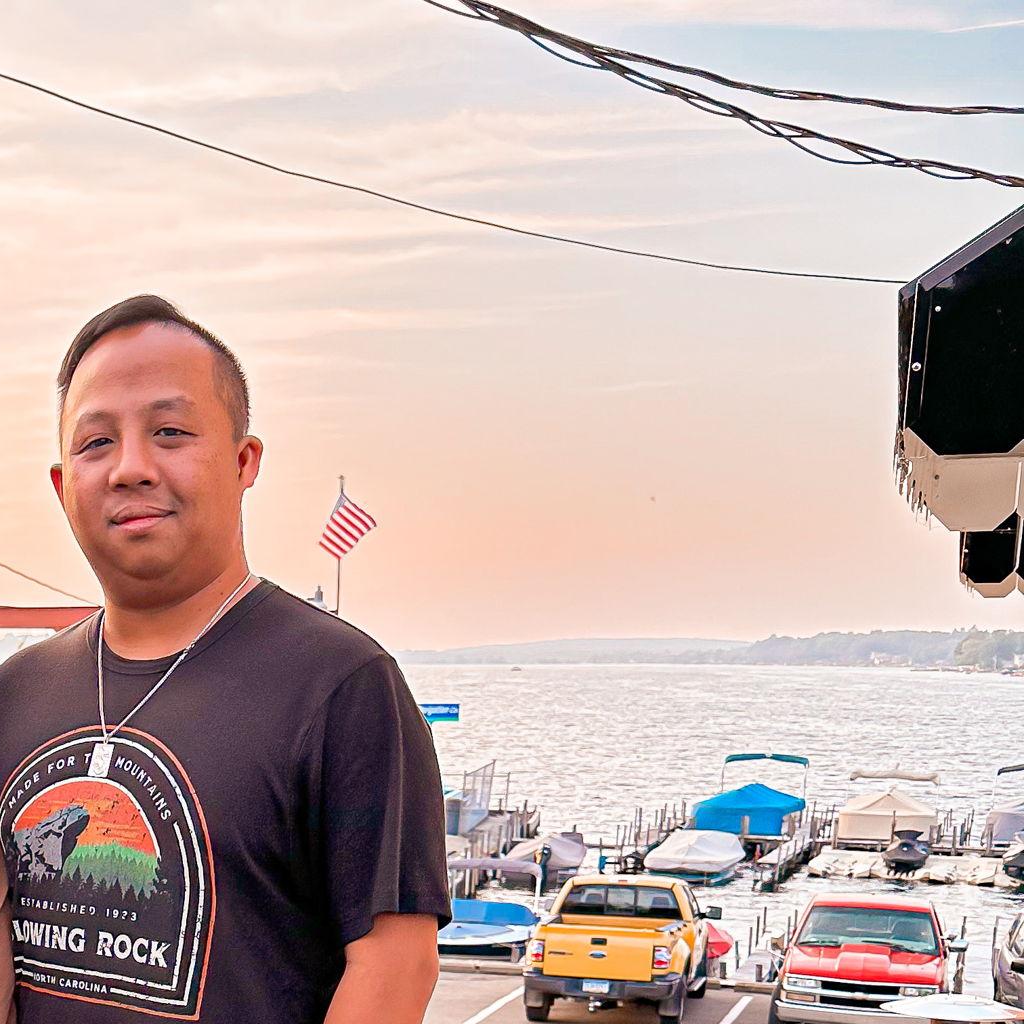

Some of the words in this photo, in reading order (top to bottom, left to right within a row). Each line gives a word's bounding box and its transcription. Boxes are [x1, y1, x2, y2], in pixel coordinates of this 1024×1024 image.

[8, 772, 40, 809] MADE
[47, 756, 75, 774] FOR
[114, 756, 172, 820] MOUNTAINS
[20, 897, 96, 916] ESTABLISHED
[12, 919, 86, 953] LOWING
[96, 930, 171, 968] ROCK
[59, 978, 108, 994] CAROLINA
